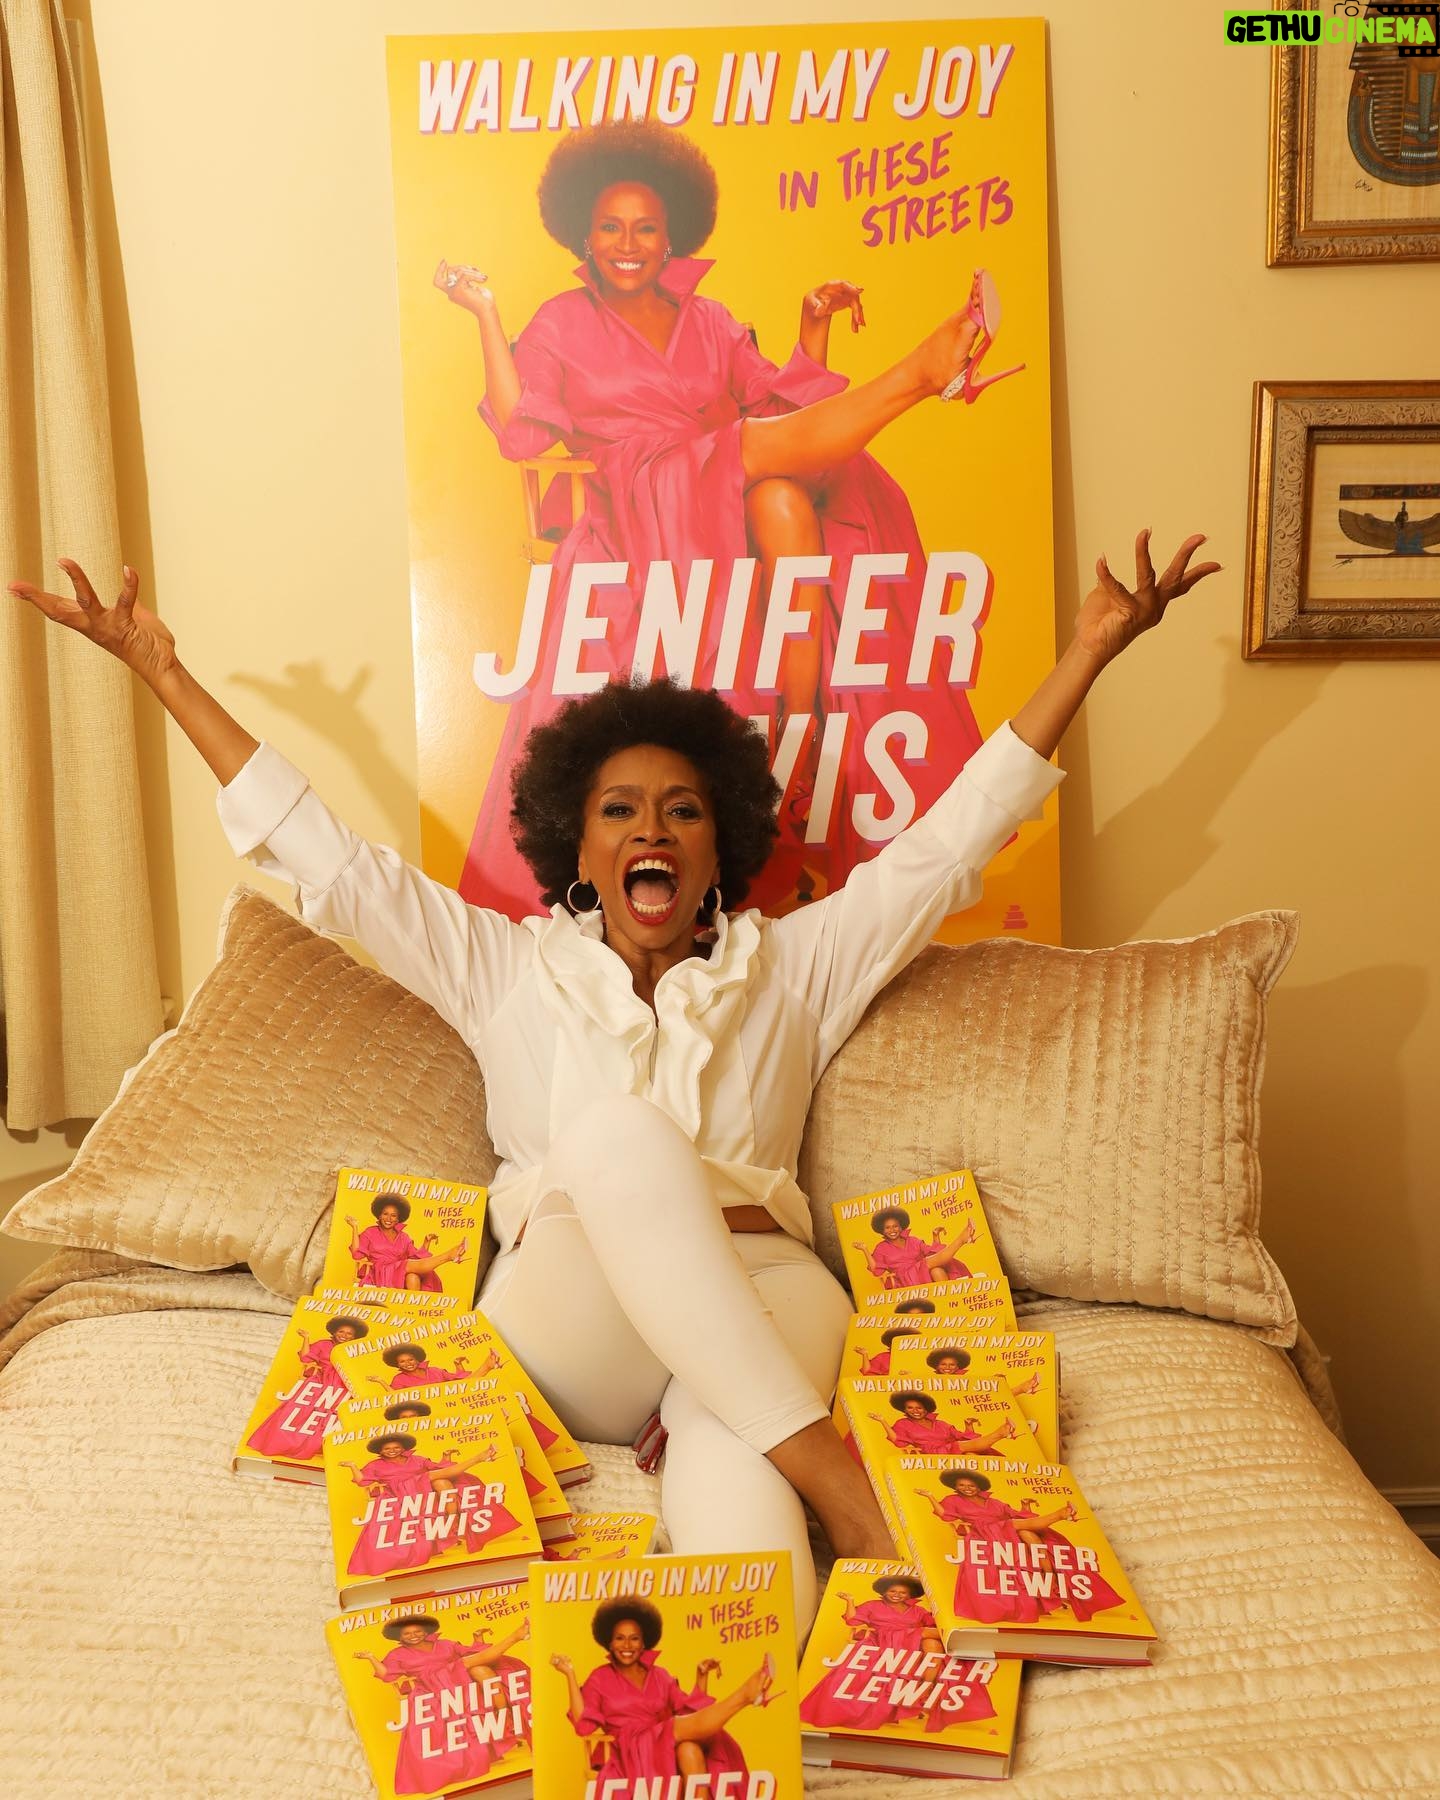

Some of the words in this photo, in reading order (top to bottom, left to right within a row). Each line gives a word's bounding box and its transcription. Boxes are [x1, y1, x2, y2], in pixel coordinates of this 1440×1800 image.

[418, 52, 698, 134] WALKING
[712, 50, 781, 127] IN
[789, 47, 891, 123] MY
[892, 44, 1015, 120] JOY
[778, 171, 820, 212] IN
[837, 131, 952, 201] THESE
[862, 176, 1014, 247] STREETS
[473, 551, 995, 698] JENIFER
[348, 1174, 411, 1198] WALKING
[413, 1184, 429, 1199] IN
[430, 1188, 453, 1202] MY
[452, 1190, 479, 1205] JOY
[841, 1193, 900, 1220] WALKING
[903, 1187, 917, 1204] IN
[919, 1183, 939, 1199] MY
[942, 1175, 965, 1194] JOY
[424, 1209, 433, 1218] IN
[438, 1207, 463, 1217] THESE
[921, 1207, 930, 1216] IN
[933, 1194, 958, 1210] THESE
[941, 1200, 973, 1219] STREETS
[441, 1218, 475, 1228] STREETS
[322, 1289, 387, 1302] WALKING
[391, 1292, 405, 1304] IN
[408, 1295, 430, 1305] MY
[432, 1296, 459, 1308] JOY
[866, 1289, 929, 1306] WALKING
[933, 1285, 947, 1296] IN
[950, 1281, 974, 1294] MY
[974, 1279, 1000, 1291] JOY
[963, 1294, 988, 1304] THESE
[304, 1299, 372, 1320] WALKING
[373, 1311, 391, 1324] IN
[418, 1309, 445, 1317] THESE
[969, 1299, 1004, 1312] STREETS
[856, 1316, 922, 1328] WALKING
[924, 1317, 940, 1328] IN
[942, 1317, 967, 1328] MY
[968, 1316, 996, 1328] JOY
[345, 1332, 410, 1359] WALKING
[413, 1325, 432, 1339] IN
[431, 1320, 451, 1335] MY
[454, 1313, 478, 1329] JOY
[437, 1341, 447, 1349] IN
[448, 1328, 474, 1344] THESE
[459, 1334, 492, 1350] STREETS
[899, 1336, 968, 1351] WALKING
[970, 1335, 989, 1348] IN
[992, 1335, 1016, 1348] MY
[1015, 1336, 1046, 1348] JOY
[1001, 1350, 1030, 1360] THESE
[1006, 1358, 1045, 1368] STREETS
[348, 1391, 421, 1414] WALKING
[425, 1387, 442, 1400] IN
[443, 1381, 467, 1395] MY
[470, 1377, 500, 1391] JOY
[853, 1378, 923, 1392] WALKING
[928, 1378, 944, 1391] IN
[948, 1379, 968, 1391] MY
[973, 1379, 999, 1392] JOY
[445, 1400, 457, 1409] IN
[460, 1392, 489, 1404] THESE
[468, 1395, 507, 1410] STREETS
[964, 1393, 992, 1404] THESE
[974, 1401, 1010, 1412] STREETS
[331, 1423, 409, 1446] WALKING
[413, 1418, 432, 1431] IN
[434, 1416, 460, 1429] MY
[461, 1413, 494, 1427] JOY
[433, 1433, 445, 1441] IN
[450, 1427, 480, 1439] THESE
[457, 1431, 498, 1444] STREETS
[900, 1457, 979, 1471] WALKING
[984, 1458, 1000, 1471] IN
[1004, 1461, 1028, 1474] MY
[1029, 1464, 1062, 1478] JOY
[1022, 1477, 1053, 1486] THESE
[1032, 1486, 1072, 1495] STREETS
[352, 1482, 506, 1527] JENIFER
[375, 1509, 493, 1550] LEWIS
[583, 1516, 612, 1527] MY
[611, 1516, 644, 1526] JOY
[592, 1527, 625, 1537] THESE
[595, 1533, 639, 1542] STREETS
[945, 1539, 1099, 1572] JENIFER
[544, 1569, 655, 1603] WALKING
[659, 1567, 687, 1597] IN
[690, 1564, 729, 1595] MY
[730, 1562, 777, 1593] JOY
[977, 1568, 1094, 1600] LEWIS
[339, 1601, 427, 1633] WALKING
[431, 1598, 451, 1612] IN
[455, 1591, 484, 1608] MY
[487, 1584, 519, 1599] JOY
[457, 1613, 470, 1621] IN
[475, 1599, 509, 1615] THESE
[485, 1601, 530, 1621] STREETS
[687, 1614, 703, 1631] IN
[710, 1597, 754, 1625] THESE
[720, 1614, 779, 1644] STREETS
[822, 1643, 999, 1685] JENIFER
[386, 1669, 530, 1732] JENIFE
[833, 1673, 971, 1712] LEWIS
